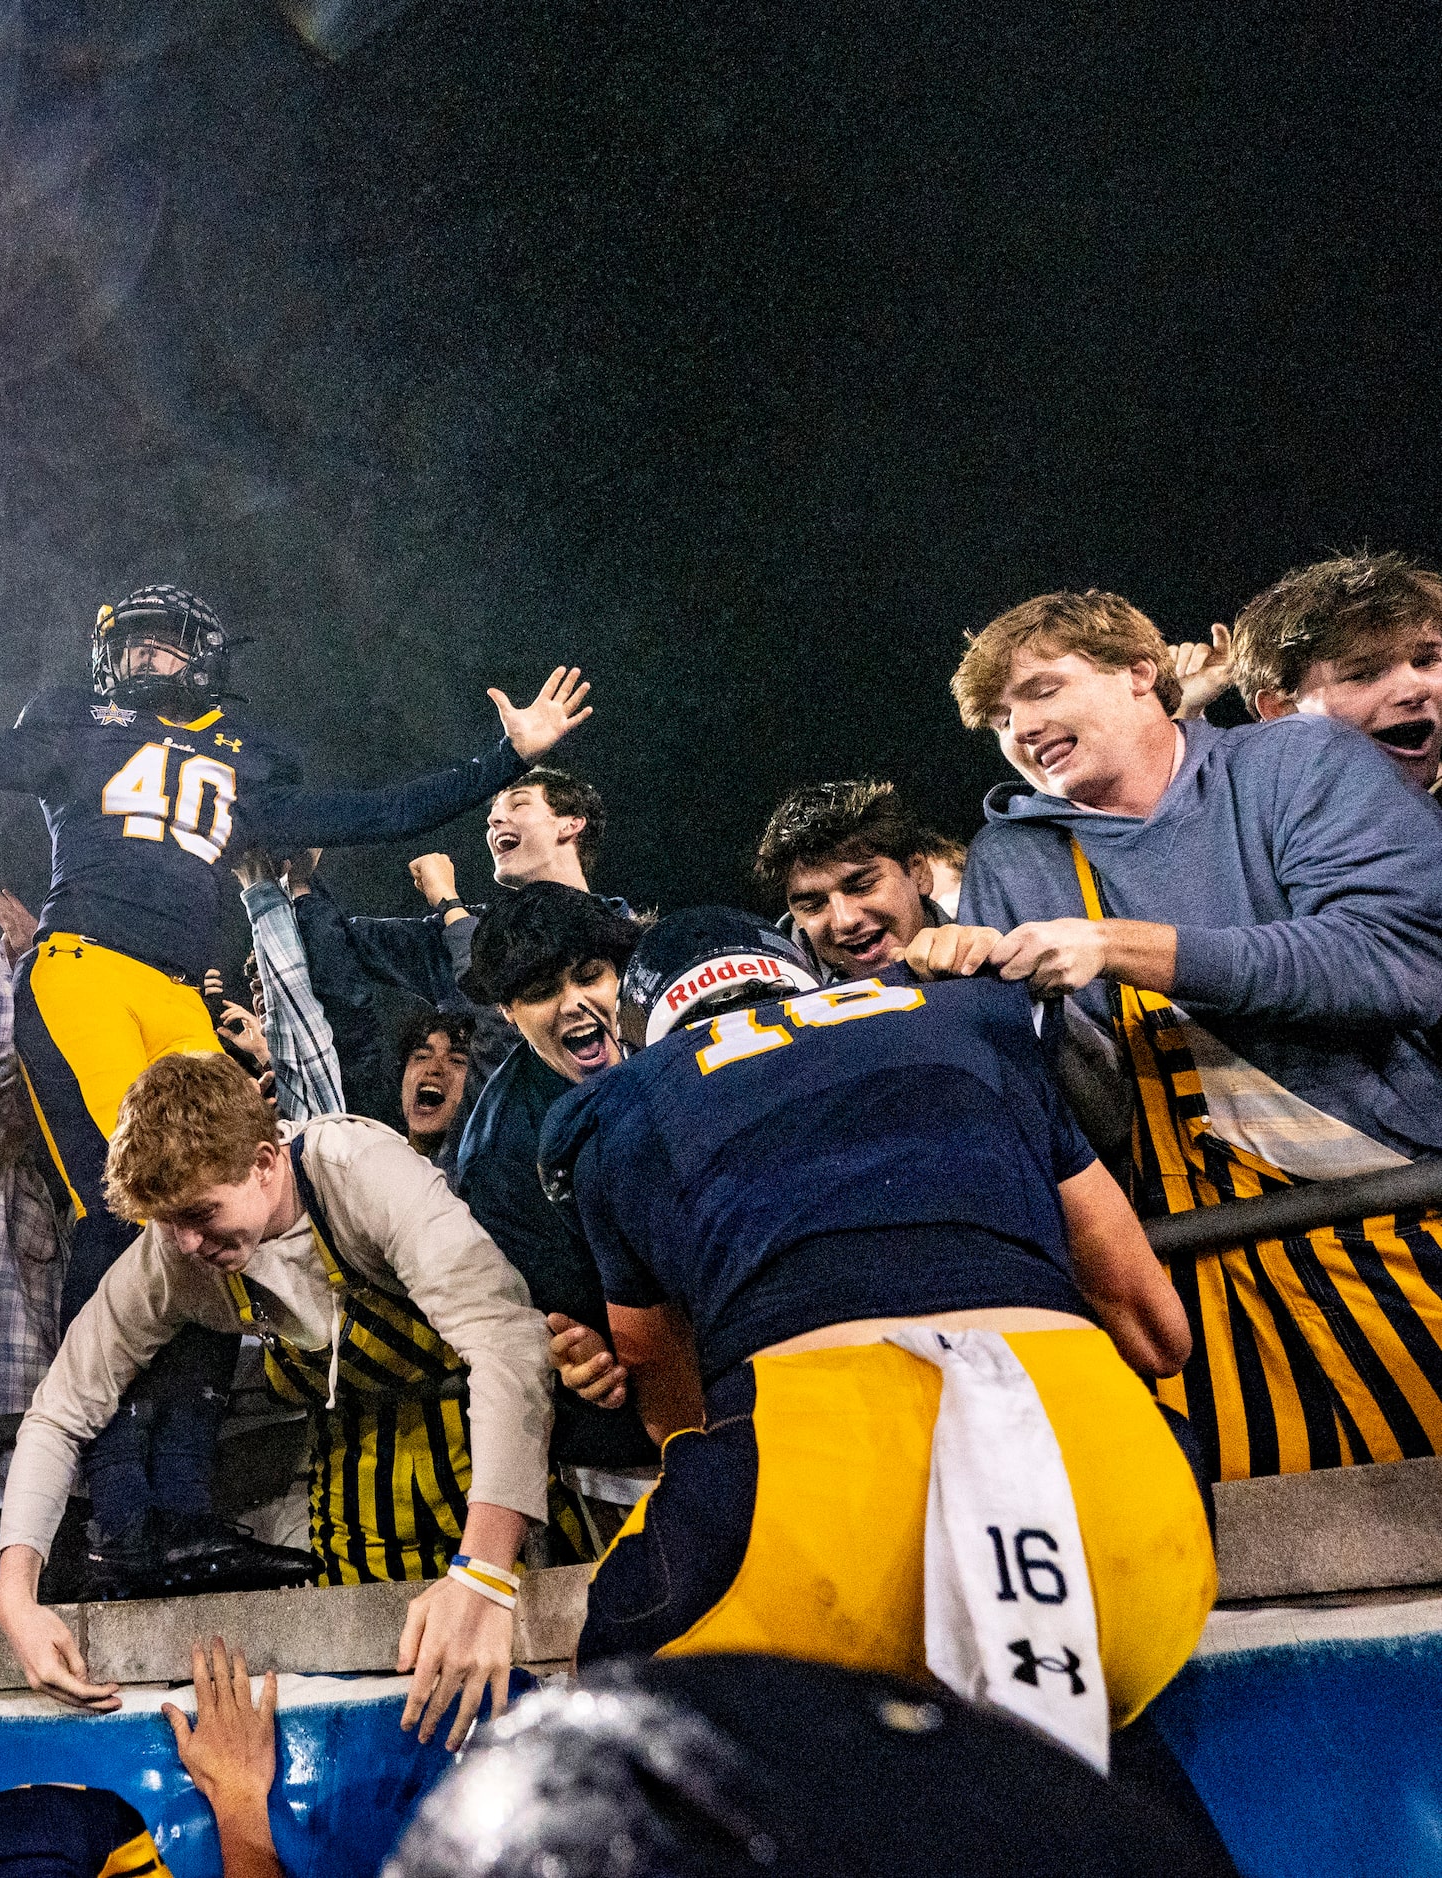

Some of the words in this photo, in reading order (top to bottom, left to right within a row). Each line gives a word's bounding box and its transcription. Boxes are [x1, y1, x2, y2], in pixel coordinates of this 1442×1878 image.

[101, 741, 237, 865] 40
[665, 958, 781, 1012] Riddell
[986, 1524, 1068, 1605] 16
